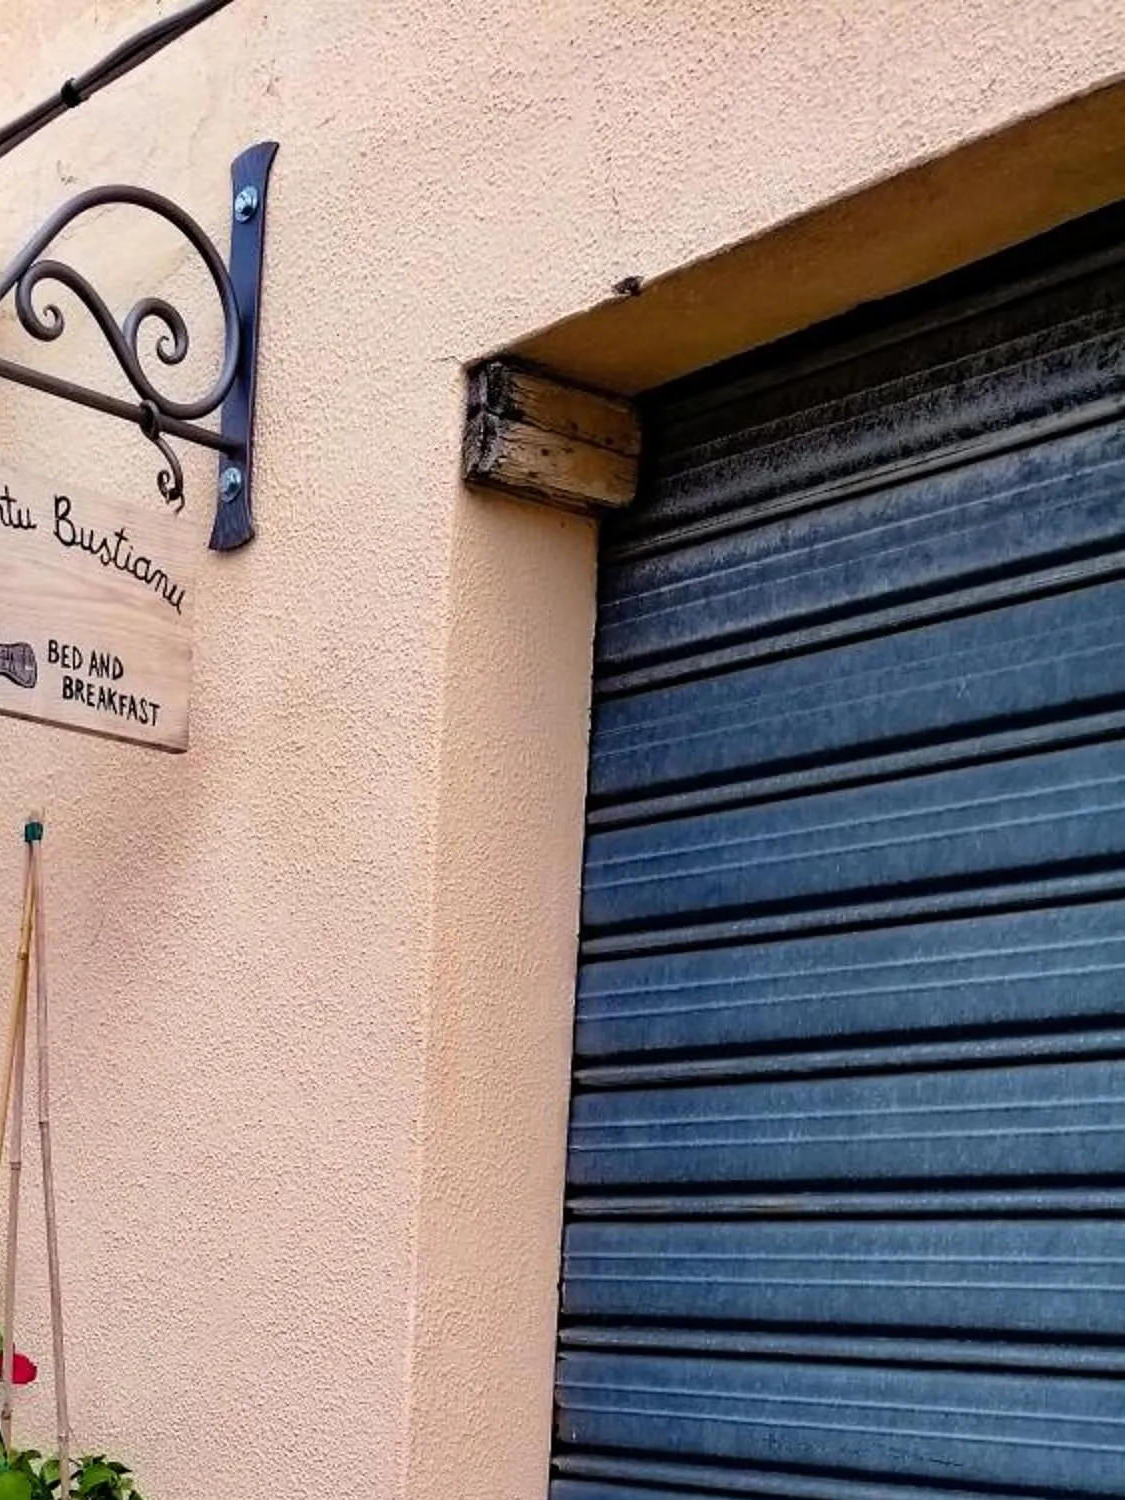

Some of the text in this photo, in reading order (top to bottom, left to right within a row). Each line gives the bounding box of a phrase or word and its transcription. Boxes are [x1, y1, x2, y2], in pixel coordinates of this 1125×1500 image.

[53, 496, 187, 615] Bustianu
[47, 639, 125, 681] BED AND
[61, 676, 160, 727] BREAKFAST
